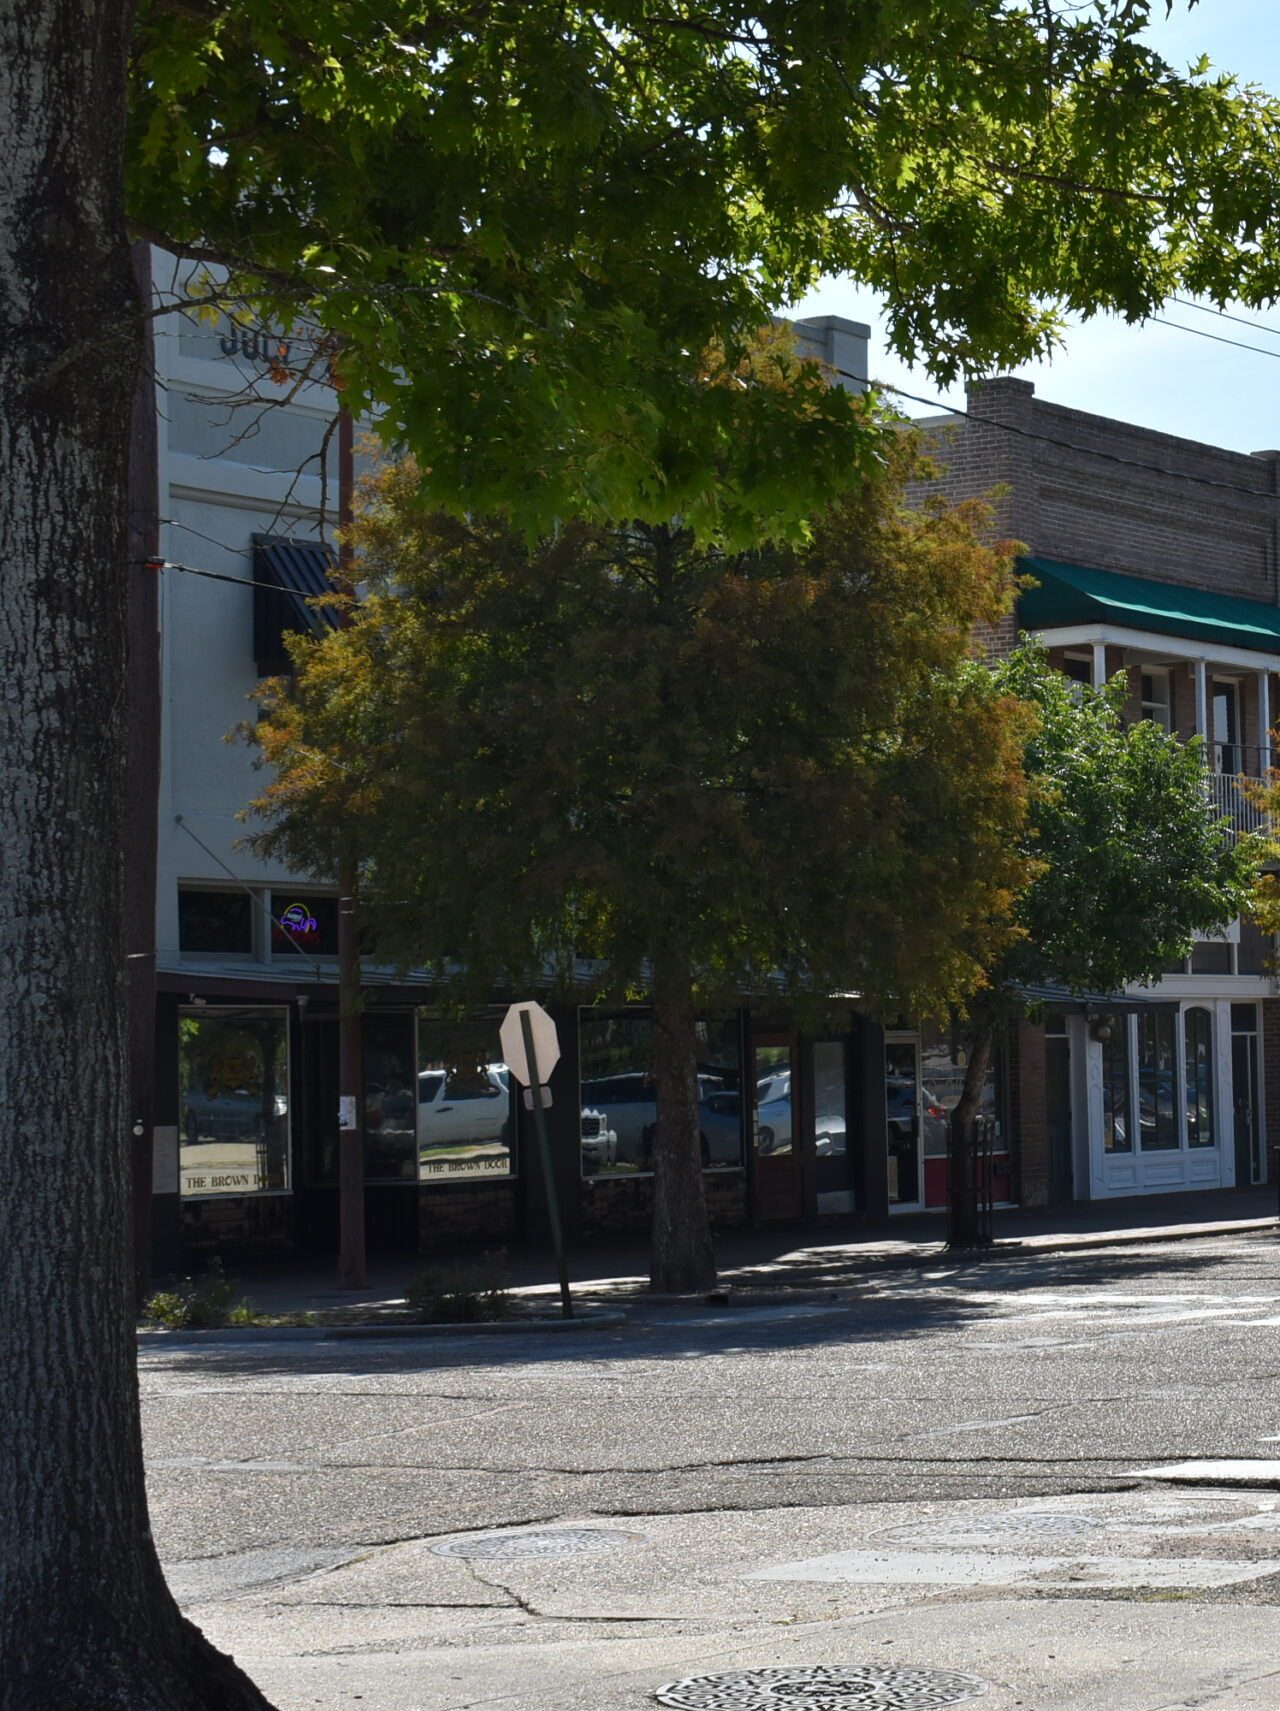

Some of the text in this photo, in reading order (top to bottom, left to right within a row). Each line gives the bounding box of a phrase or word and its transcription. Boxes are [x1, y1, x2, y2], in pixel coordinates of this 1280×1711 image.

[428, 1158, 508, 1173] THE BROWN DOOR
[186, 1176, 207, 1189] THE
[211, 1174, 249, 1187] BROWN
